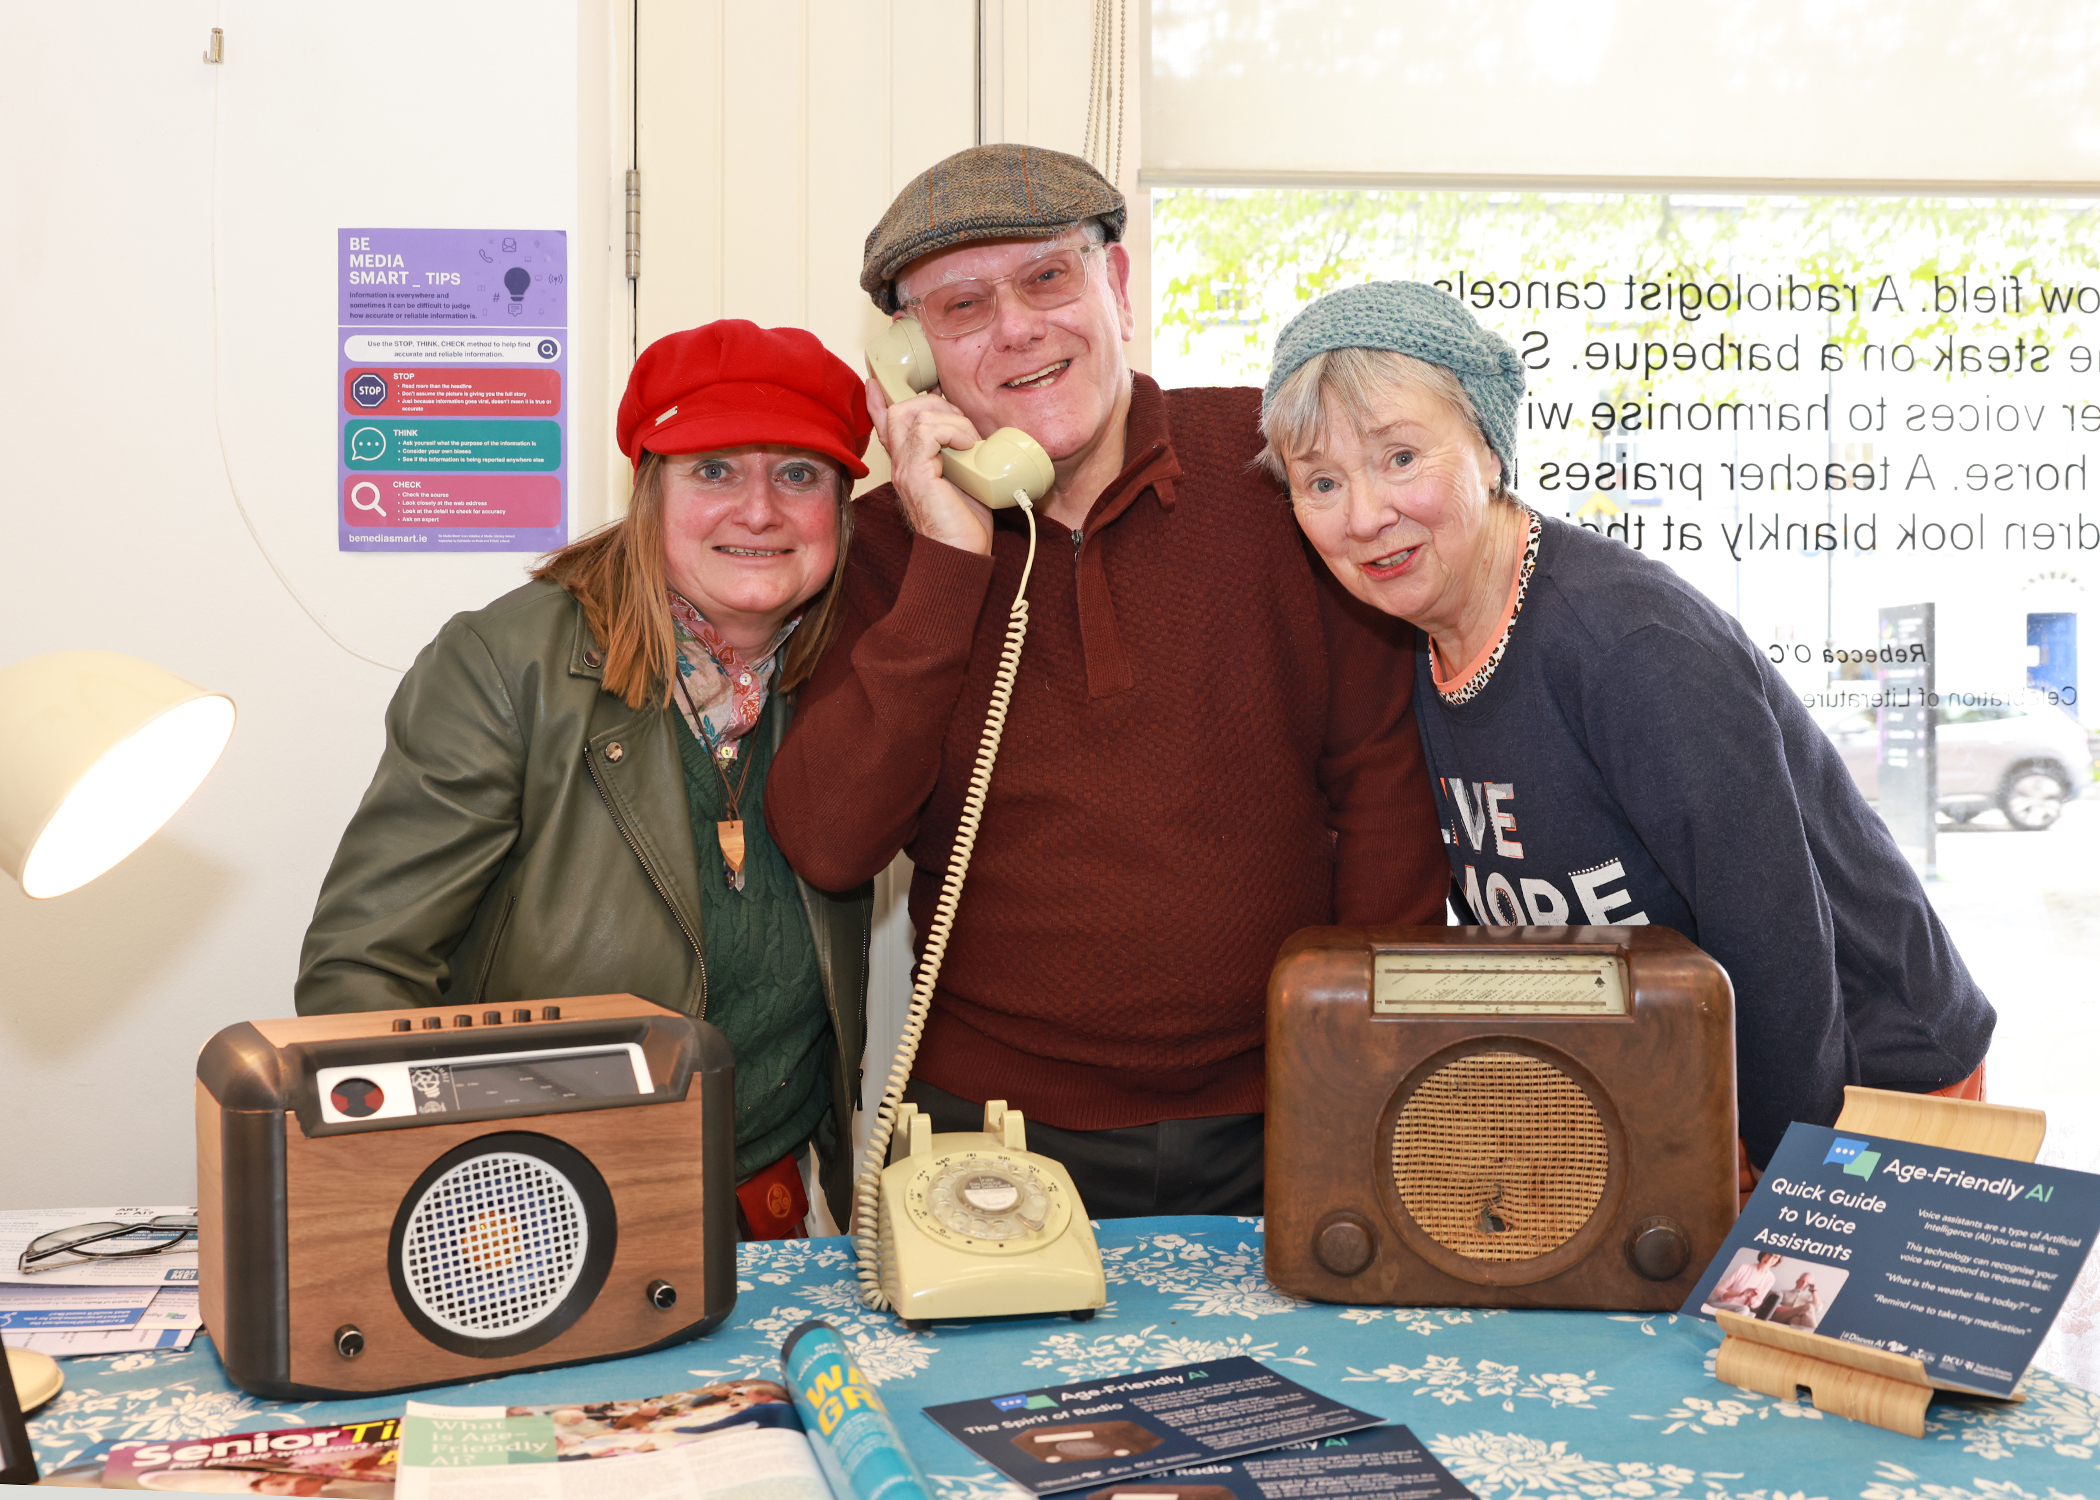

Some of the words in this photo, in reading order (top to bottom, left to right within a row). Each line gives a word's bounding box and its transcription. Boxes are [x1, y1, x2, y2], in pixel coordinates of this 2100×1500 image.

[349, 237, 371, 251] BE
[349, 254, 405, 268] MEDIA
[349, 271, 409, 285] SMART
[425, 272, 461, 286] TIPS
[396, 292, 435, 300] everywhere
[451, 302, 471, 310] judge
[367, 340, 381, 348] Use
[382, 340, 393, 348] the
[394, 340, 415, 348] STOP,
[416, 340, 440, 348] THINK,
[440, 340, 466, 348] CHECK
[466, 340, 492, 348] method
[493, 340, 501, 348] to
[501, 340, 517, 350] help
[517, 340, 531, 349] find
[464, 351, 504, 359] information.
[393, 372, 415, 381] STOP
[358, 385, 382, 396] STOP
[393, 429, 418, 437] THINK
[392, 481, 422, 489] CHECK
[348, 534, 428, 544] bemediasmart.ie
[1882, 1158, 2025, 1202] Age-Friendly
[2024, 1183, 2055, 1203] AI
[1771, 1177, 1826, 1201] Quick
[1828, 1189, 1888, 1213] Guide
[1778, 1206, 1798, 1223] to
[1804, 1210, 1857, 1235] Voice
[1918, 1208, 1941, 1220] Voice
[1941, 1214, 1983, 1229] assistants
[1984, 1222, 1999, 1232] are
[2008, 1227, 2029, 1239] type
[2030, 1230, 2042, 1240] of
[2041, 1233, 2082, 1248] Artificial
[1753, 1227, 1853, 1261] Assistants
[1923, 1221, 1973, 1239] Intelligence
[1974, 1232, 1992, 1243] (AI)
[1990, 1237, 2009, 1246] you
[2010, 1240, 2027, 1250] can
[2028, 1242, 2046, 1253] talk
[2047, 1247, 2060, 1256] to.
[1905, 1241, 1923, 1252] This
[1923, 1246, 1973, 1264] technology
[1973, 1257, 1990, 1266] can
[1990, 1260, 2035, 1276] recognise
[2034, 1269, 2059, 1281] your
[1899, 1253, 1923, 1264] voice
[1923, 1257, 1942, 1268] and
[1941, 1261, 1979, 1276] respond
[1979, 1269, 1991, 1279] to
[1990, 1273, 2031, 1288] requests
[2031, 1279, 2052, 1292] like:
[1911, 1278, 1920, 1288] is
[1920, 1281, 1936, 1292] the
[1937, 1285, 1974, 1299] weather
[1974, 1291, 1991, 1304] like
[2029, 1305, 2043, 1315] or
[1909, 1303, 1925, 1313] me
[1926, 1305, 1937, 1316] to
[1937, 1309, 1958, 1320] take
[1958, 1314, 1974, 1326] my
[1060, 1374, 1185, 1402] Age-Friendly
[1188, 1370, 1210, 1381] AI
[431, 1420, 508, 1431] What
[963, 1423, 999, 1435] The
[1001, 1414, 1049, 1430] Spirit
[1052, 1410, 1071, 1421] of
[1072, 1402, 1124, 1417] Radio
[132, 1430, 340, 1468] Senior
[341, 1420, 401, 1443] Ti
[432, 1431, 454, 1442] is
[461, 1431, 528, 1444] Age-
[1324, 1437, 1349, 1448] AI
[431, 1441, 548, 1454] Friendly
[430, 1454, 476, 1467] AI?
[1174, 1464, 1234, 1477] Radio
